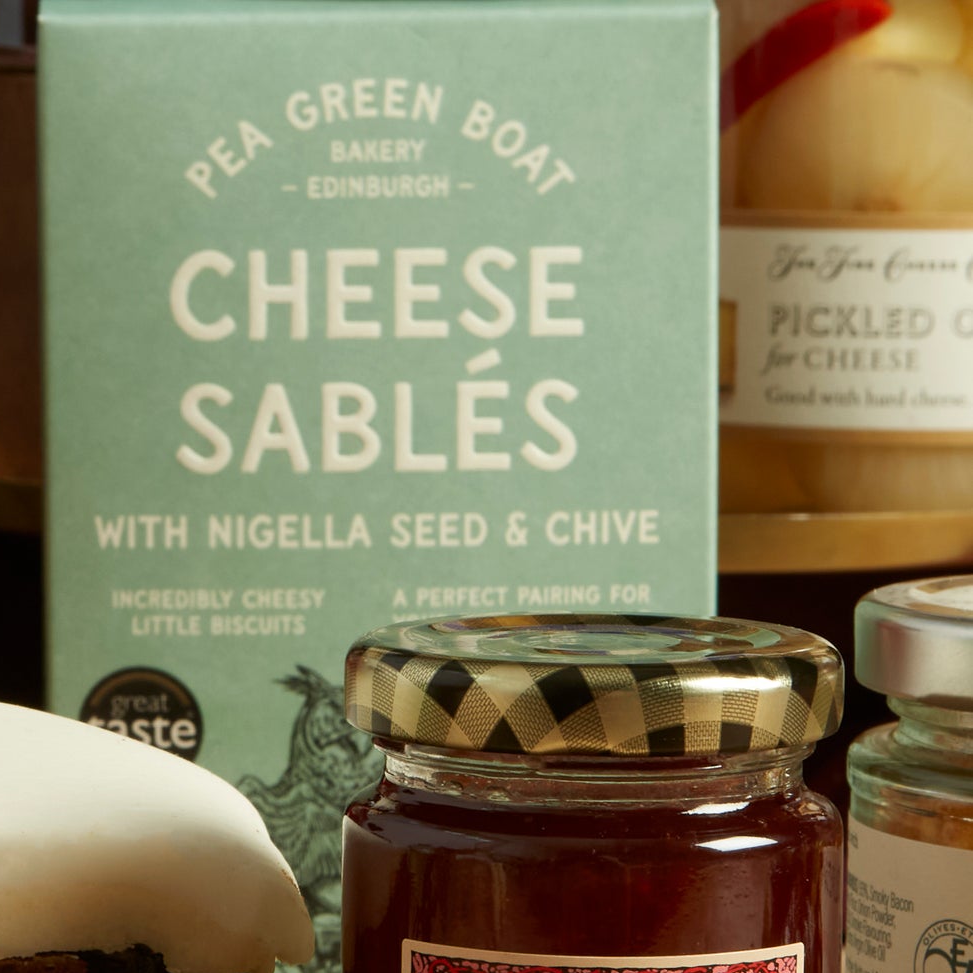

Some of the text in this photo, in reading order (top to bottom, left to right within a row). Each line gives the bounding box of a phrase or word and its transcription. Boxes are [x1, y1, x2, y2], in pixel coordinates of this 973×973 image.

[185, 78, 576, 198] PEA GREEN BOAT
[330, 140, 425, 163] BAKERY
[307, 175, 450, 199] EDINBURGH
[170, 246, 584, 341] CHEESE
[769, 303, 935, 339] PICKLED
[760, 342, 919, 378] for CHEESE
[819, 385, 861, 406] with
[176, 349, 578, 474] SABLÉS
[95, 510, 660, 549] WITH NIGELLA SEED & CHIVE
[112, 589, 325, 610] INCREDIBLY CHEESY
[393, 584, 651, 608] A PERFECT PAIRING FOR
[131, 614, 306, 636] LITTLE BISCUITS
[111, 693, 169, 720] great
[891, 891, 914, 912] Bacon
[923, 923, 955, 946] OLIVES
